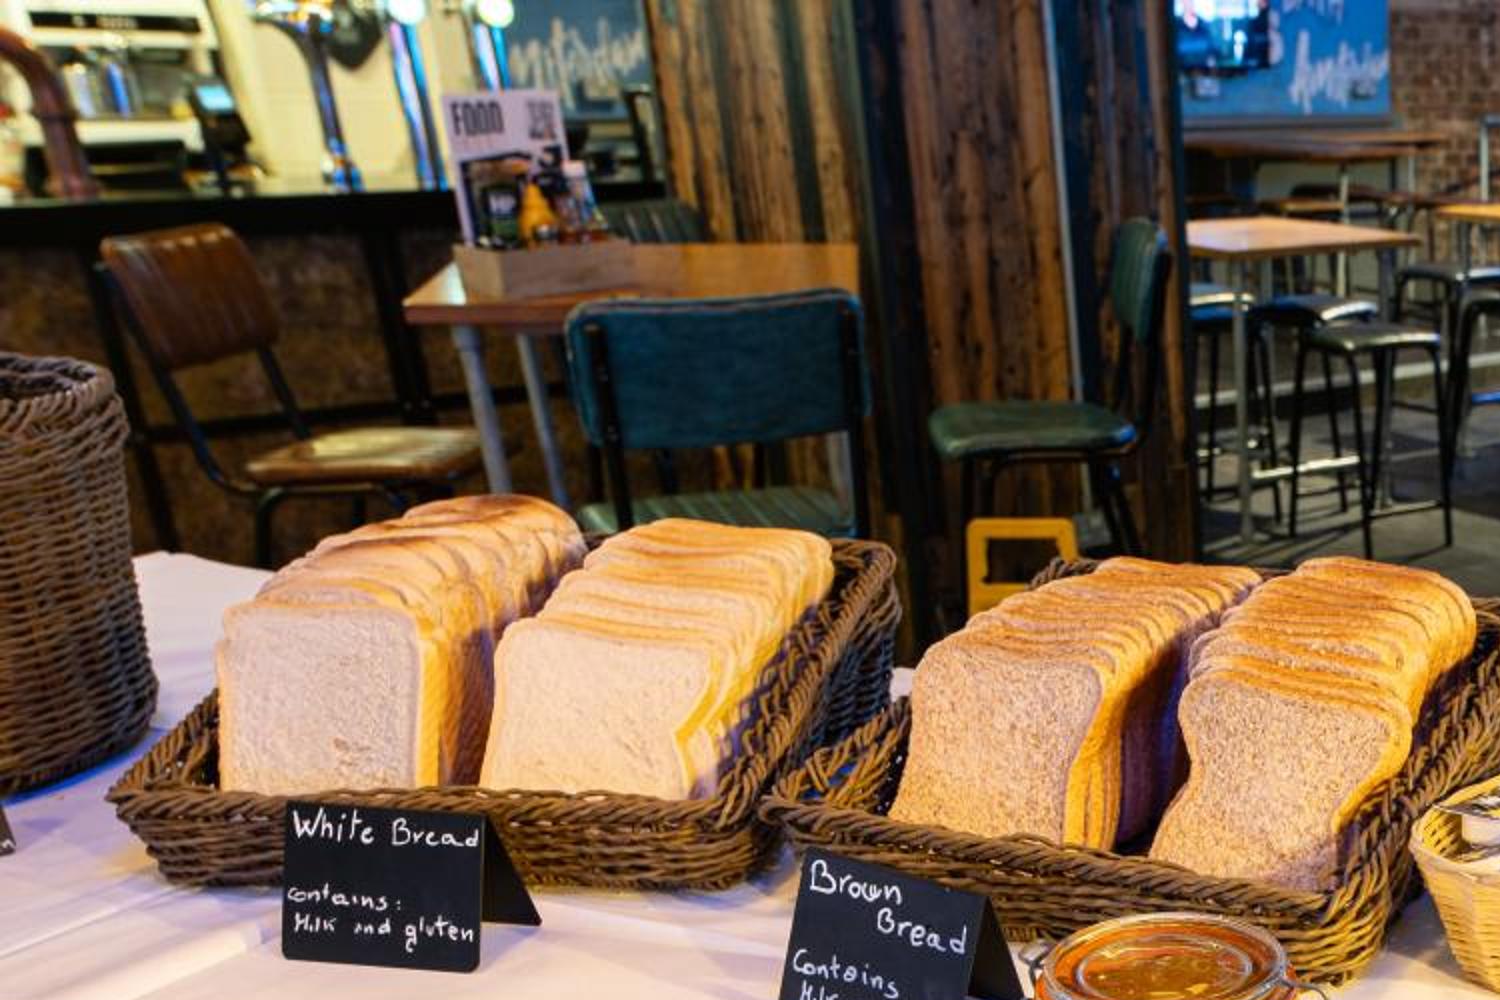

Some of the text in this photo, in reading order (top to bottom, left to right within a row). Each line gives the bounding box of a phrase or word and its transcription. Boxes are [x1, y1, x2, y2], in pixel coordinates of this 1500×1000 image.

[451, 101, 505, 137] FOOD
[292, 807, 480, 847] White Bread
[809, 859, 903, 904] Brown
[405, 916, 474, 953] gluten
[877, 907, 968, 955] Bread
[792, 949, 900, 1000] Contains
